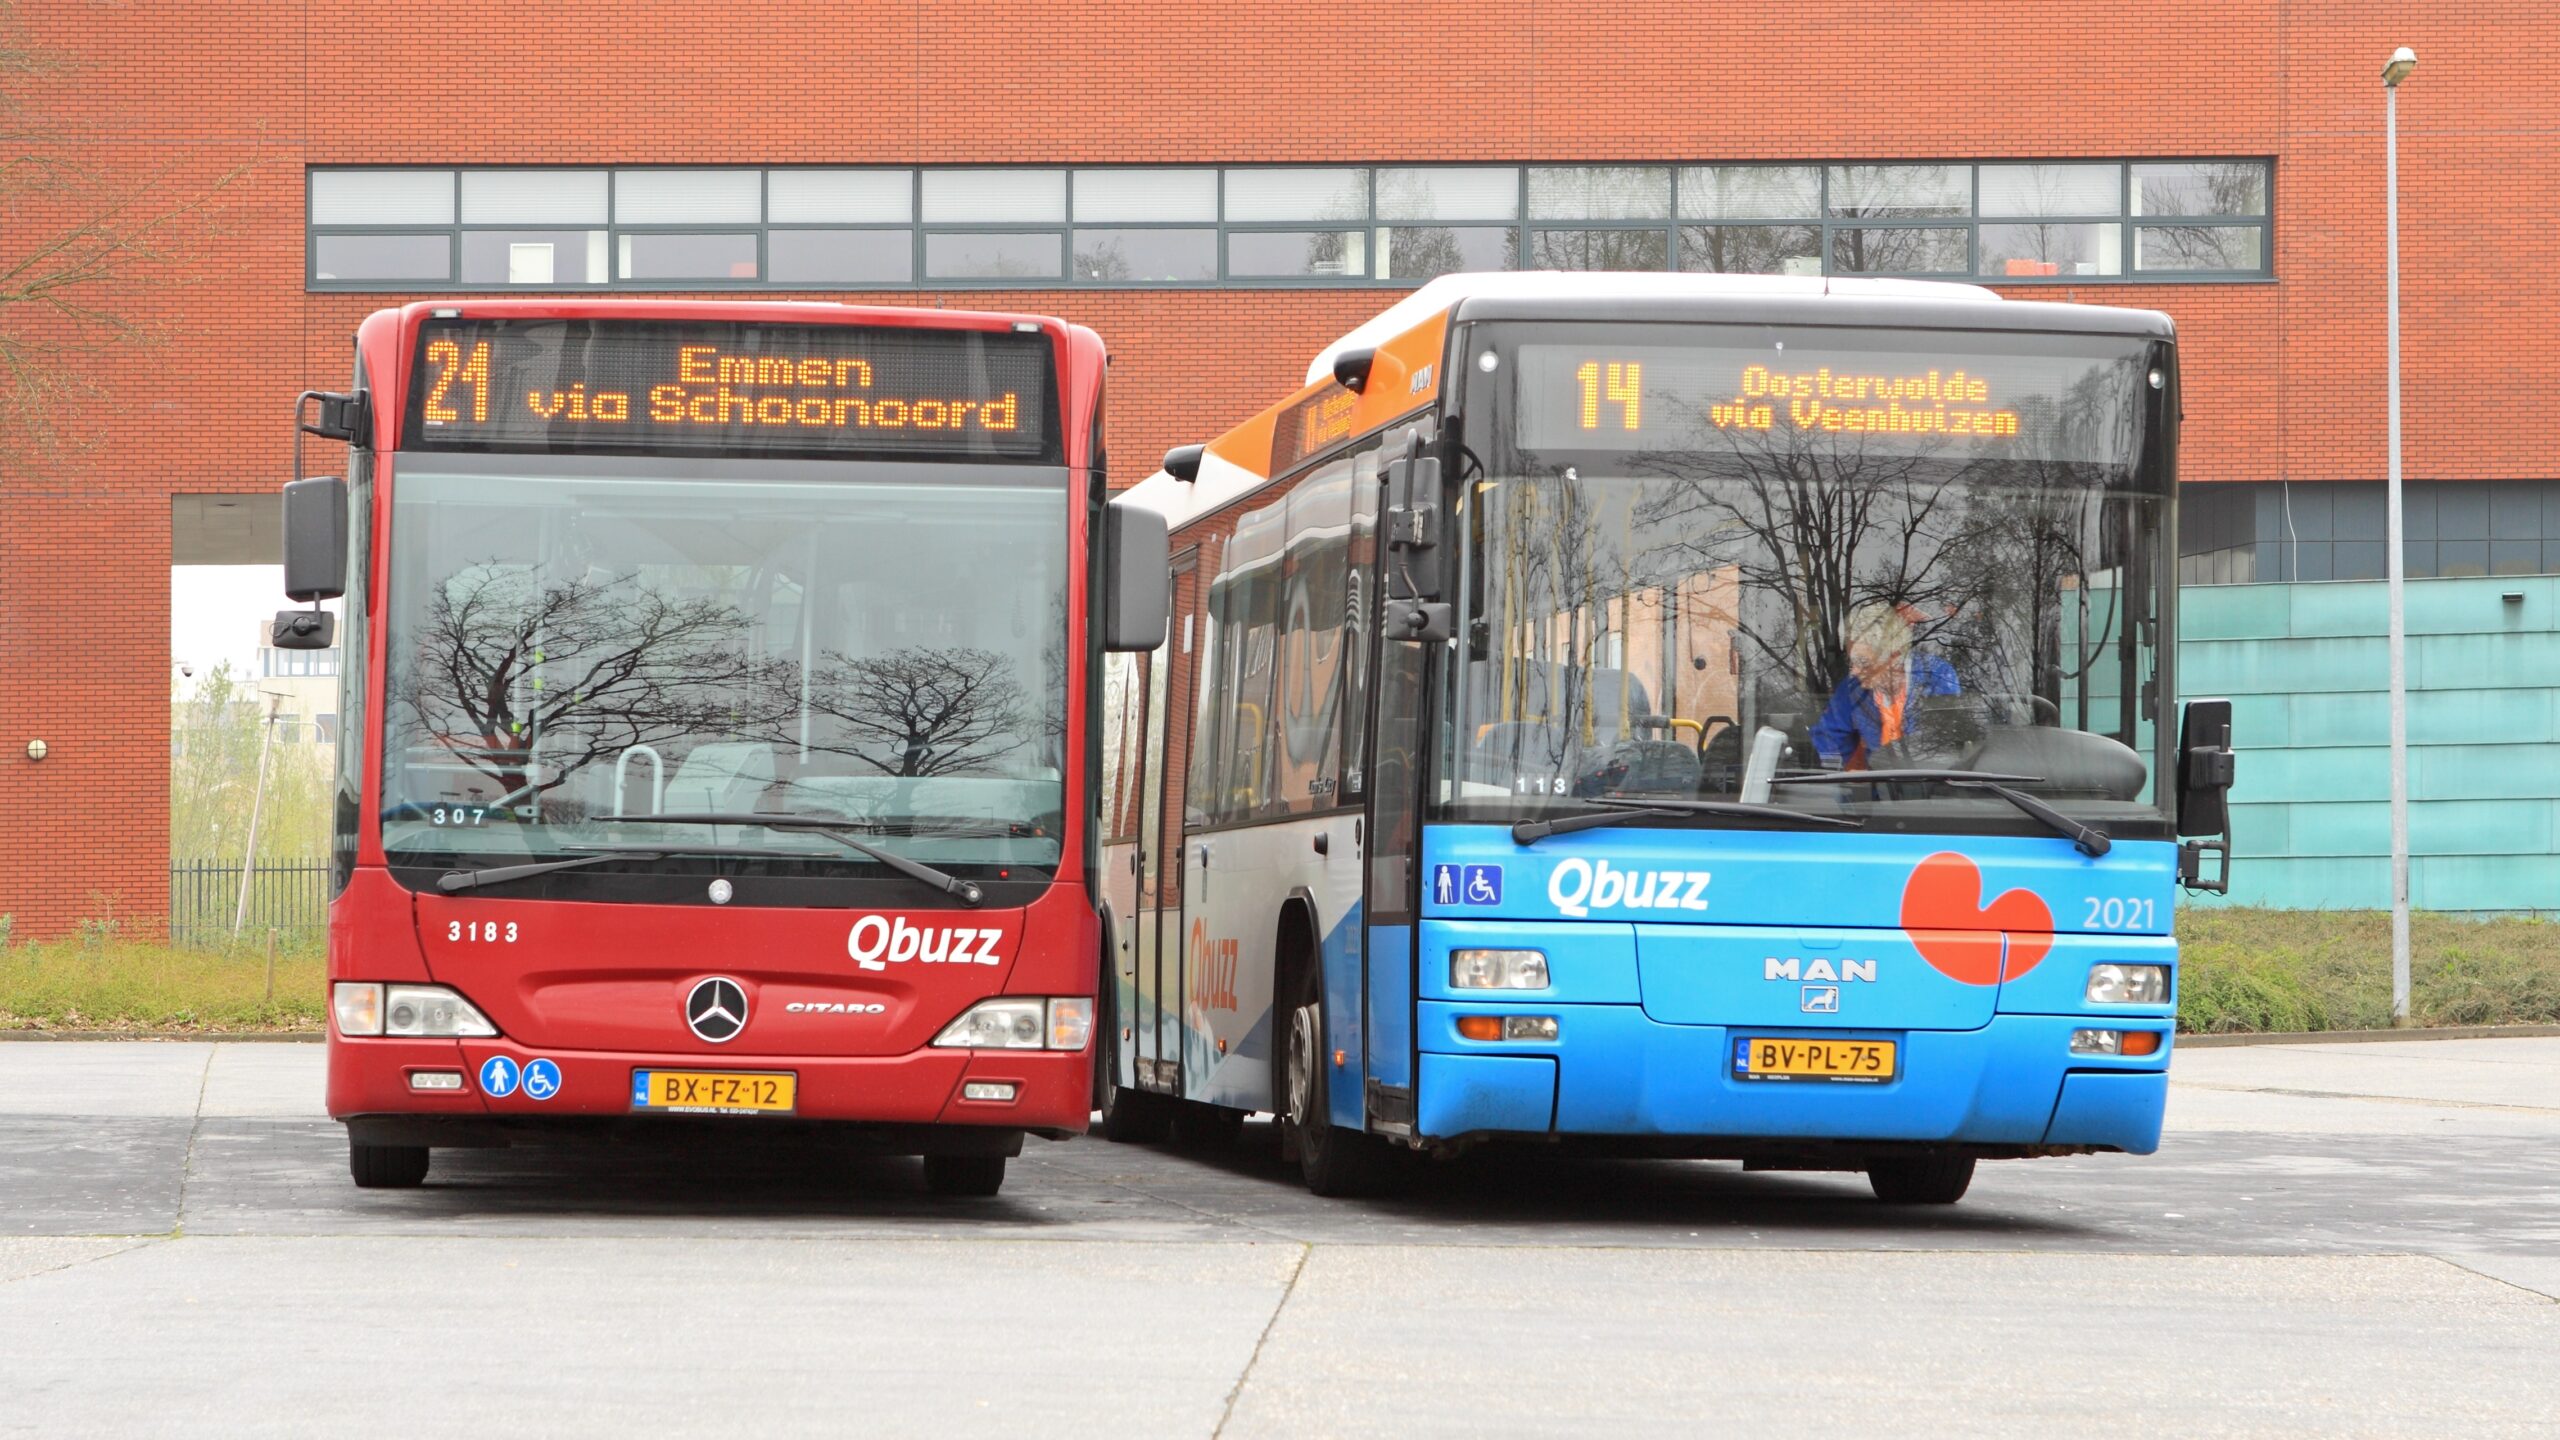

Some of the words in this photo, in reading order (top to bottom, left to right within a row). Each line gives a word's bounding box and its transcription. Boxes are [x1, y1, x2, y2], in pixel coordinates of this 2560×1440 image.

[426, 341, 488, 421] 21
[681, 346, 872, 388] Emmen
[1742, 366, 1988, 401] Oosterwolde
[528, 383, 628, 420] via
[650, 384, 1017, 429] Schoonoord
[1577, 362, 1640, 430] 14
[1711, 398, 1772, 430] via
[1790, 399, 2018, 435] Veenhuizen
[434, 808, 484, 825] 307
[1548, 857, 1712, 918] Qbuzz
[2083, 897, 2154, 930] 2021
[447, 920, 518, 943] 3183
[847, 914, 1003, 972] Qbuzz
[1189, 916, 1239, 1014] Qbuzz
[1763, 957, 1878, 983] MAN
[785, 1002, 886, 1015] CITARO
[1736, 1058, 1749, 1067] NL
[1762, 1044, 1881, 1071] BV-PL-75
[635, 1091, 648, 1101] NL
[666, 1078, 777, 1104] BX-FZ-12
